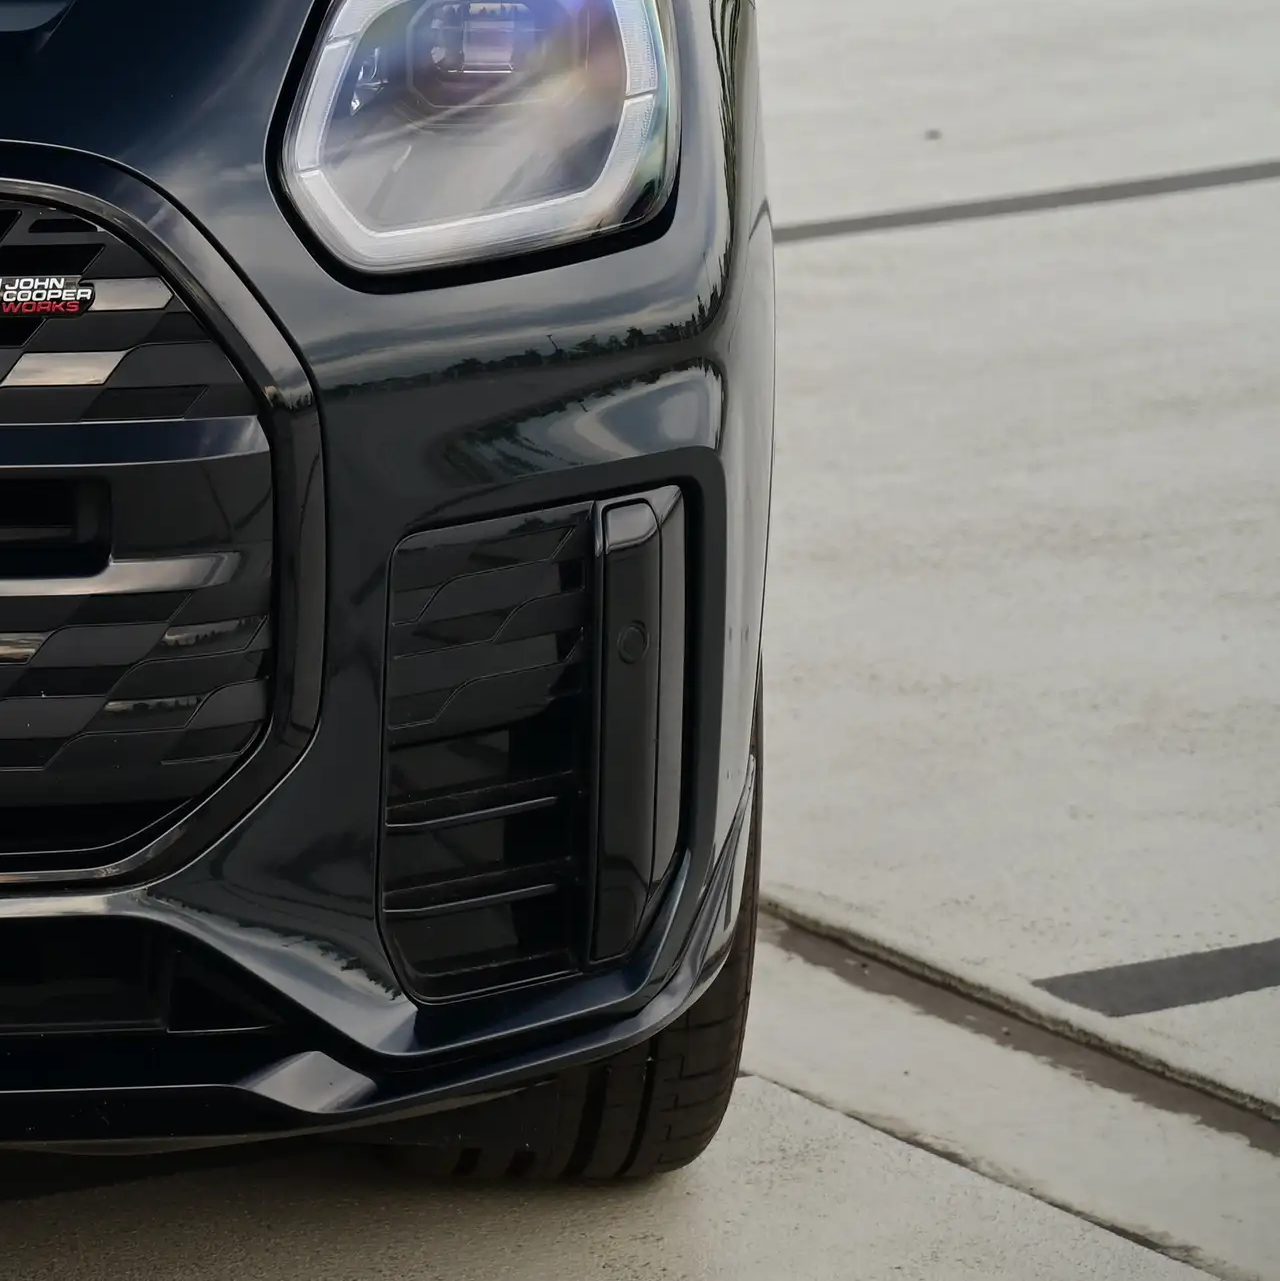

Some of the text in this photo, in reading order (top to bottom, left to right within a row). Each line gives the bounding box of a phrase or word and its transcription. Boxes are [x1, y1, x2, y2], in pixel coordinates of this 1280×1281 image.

[4, 277, 65, 290] JOHN
[2, 289, 92, 302] COOPER
[1, 301, 81, 314] WORKS
